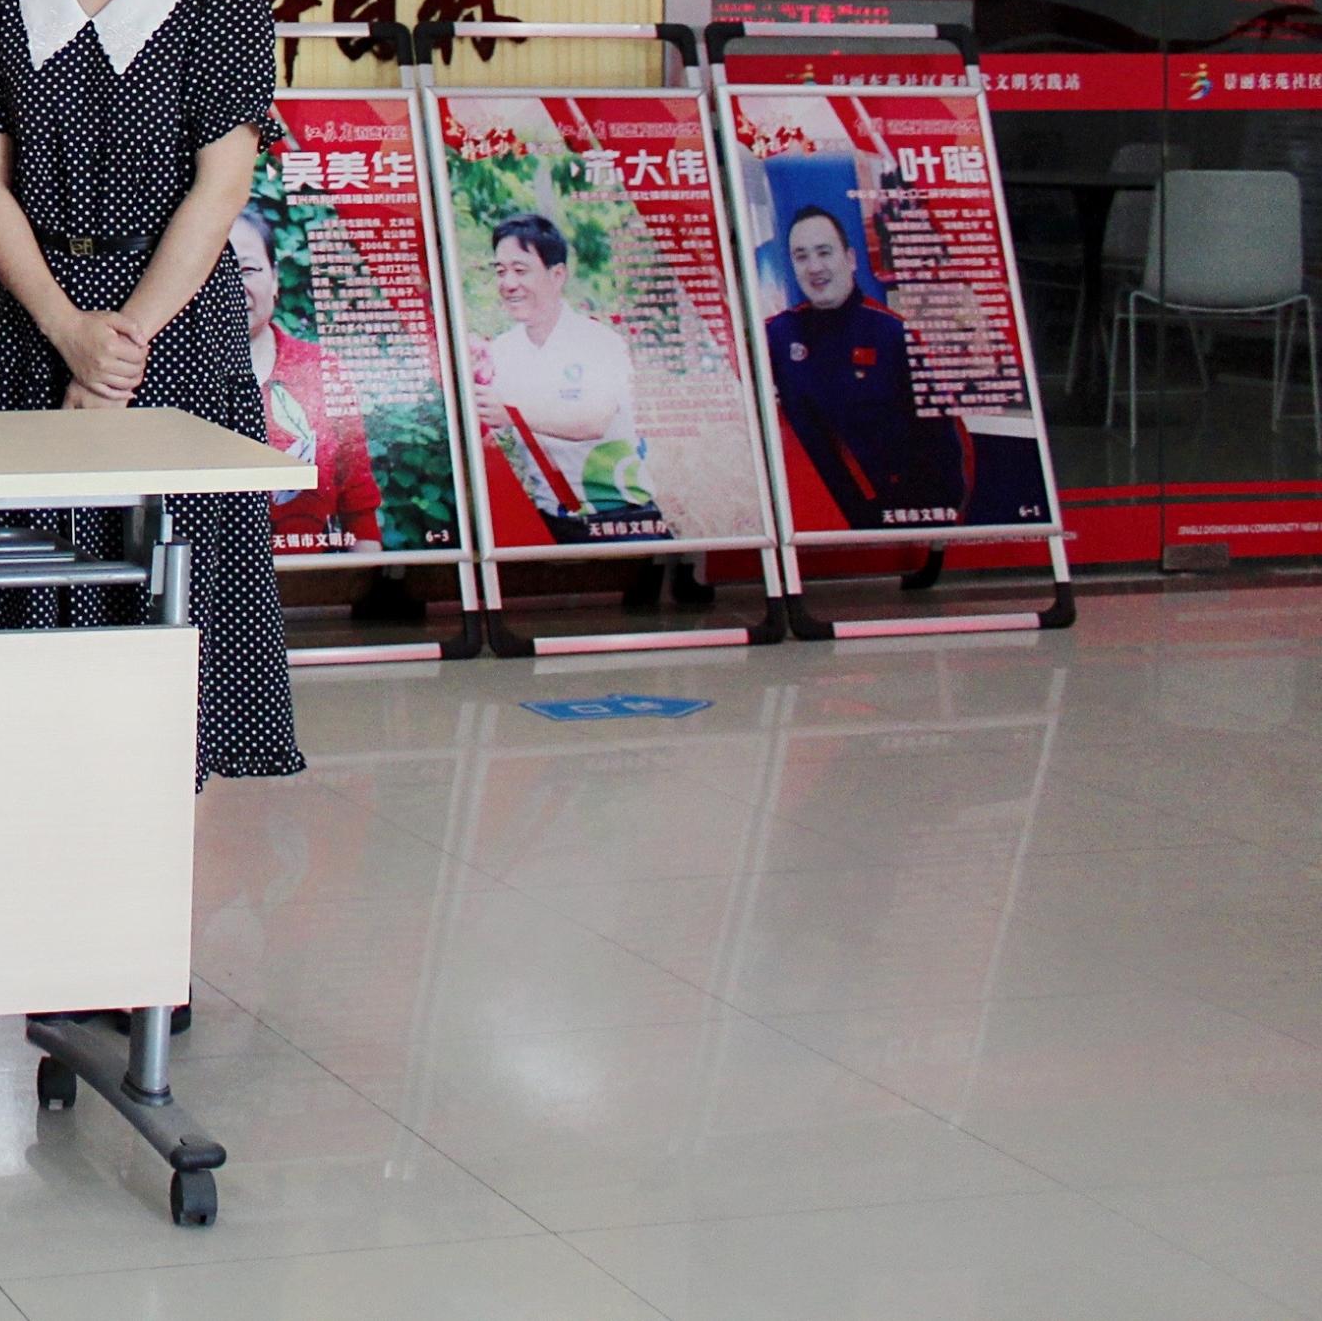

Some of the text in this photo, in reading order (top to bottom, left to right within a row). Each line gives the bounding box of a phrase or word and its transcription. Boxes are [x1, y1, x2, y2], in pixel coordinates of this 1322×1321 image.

[281, 151, 414, 192] 吴美华
[583, 149, 707, 186] 苏大伟
[897, 145, 988, 184] 叶聪
[883, 507, 958, 523] 无锡市文明办
[1019, 505, 1041, 517] 6-1
[273, 532, 357, 549] 无锡市文明办
[425, 529, 449, 543] 6-3
